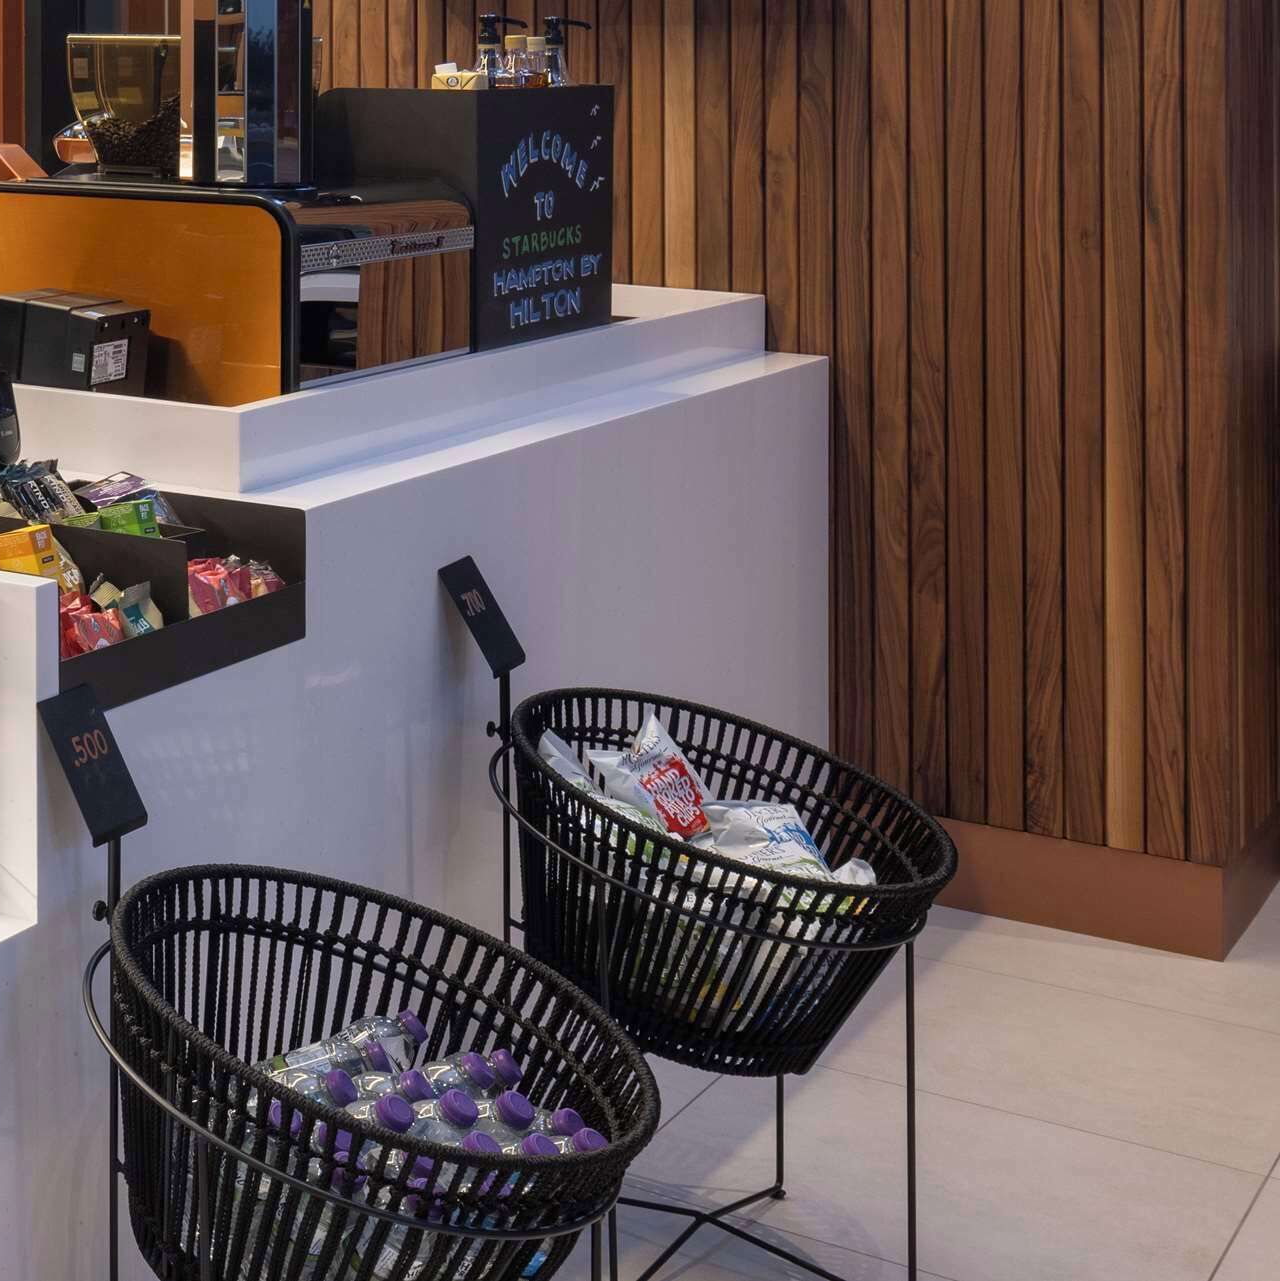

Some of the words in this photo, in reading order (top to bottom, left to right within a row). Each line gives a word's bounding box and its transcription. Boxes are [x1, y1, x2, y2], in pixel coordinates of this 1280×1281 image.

[500, 129, 591, 198] WELCOME
[534, 191, 556, 221] TO
[502, 224, 583, 260] STARBUCKS
[493, 256, 575, 296] HAMPTON
[580, 252, 603, 277] BY
[509, 287, 581, 329] HILTON
[28, 480, 50, 509] KIND
[44, 475, 67, 502] KIND
[72, 729, 108, 768] .500
[647, 768, 680, 794] HAND
